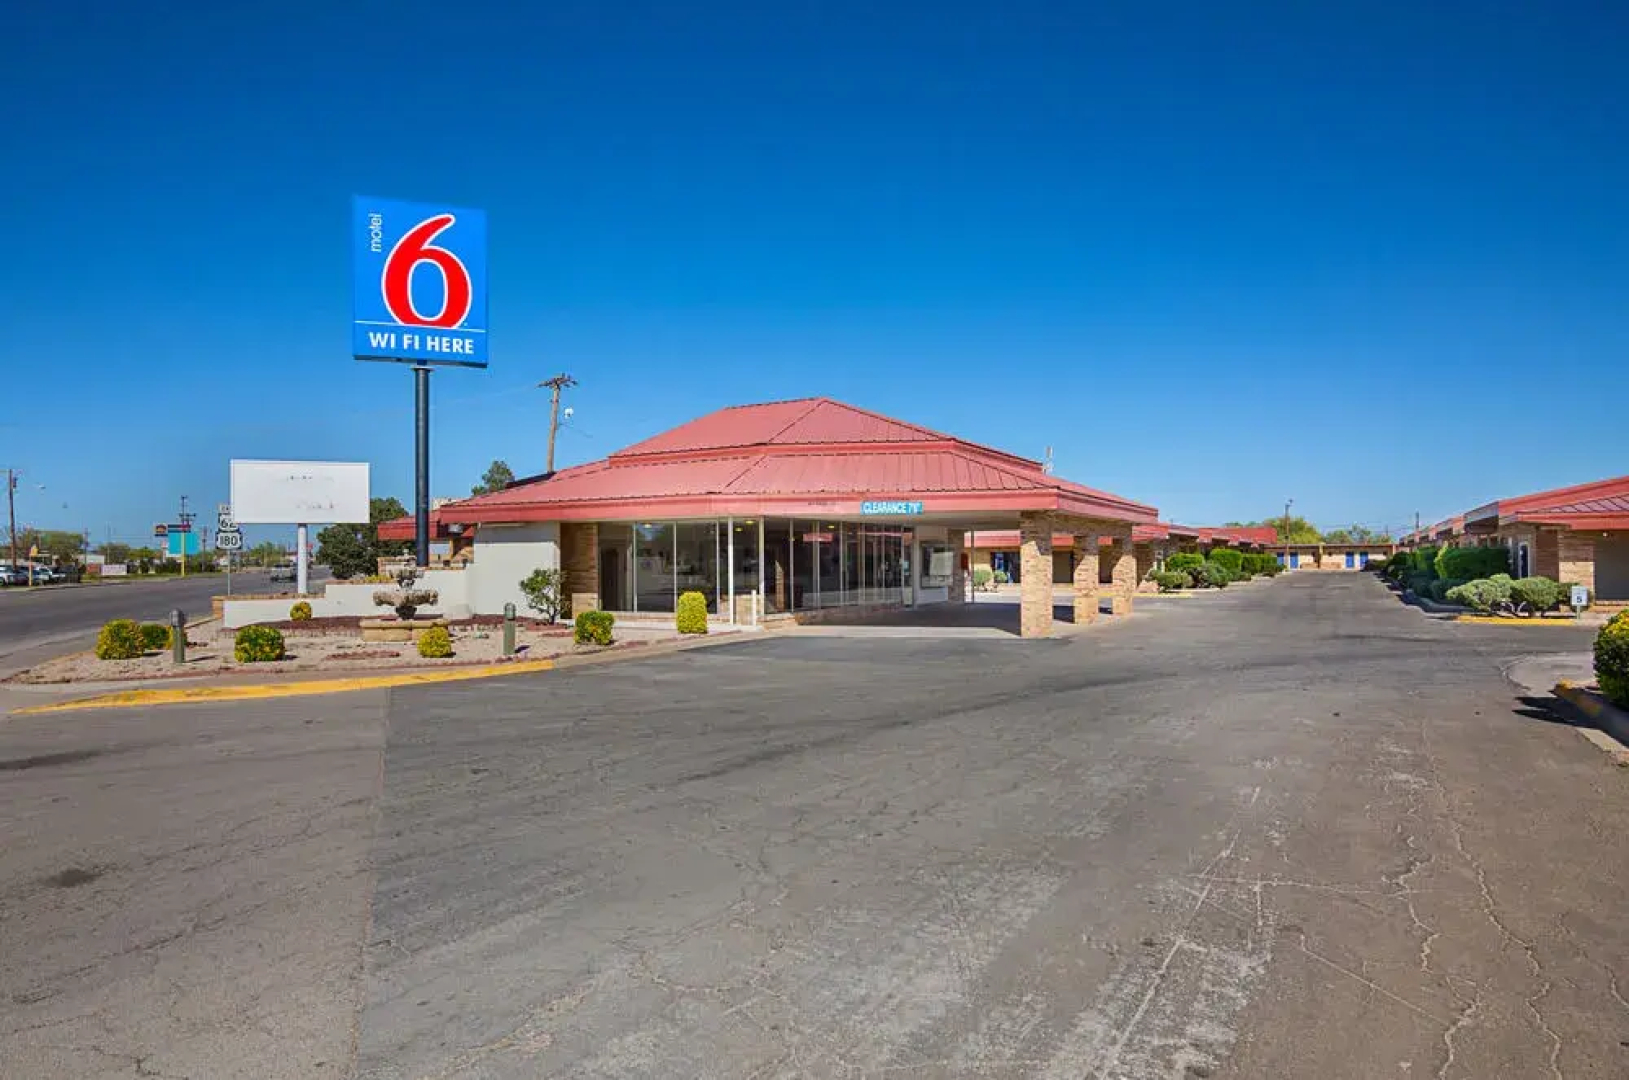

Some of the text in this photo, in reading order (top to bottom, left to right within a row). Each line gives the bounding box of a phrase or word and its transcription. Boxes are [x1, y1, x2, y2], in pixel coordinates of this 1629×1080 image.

[368, 212, 382, 252] motel
[381, 214, 472, 329] 6
[369, 332, 474, 354] WI FI HERE
[864, 501, 906, 514] CLEARANCE
[220, 535, 239, 546] 180
[1576, 595, 1583, 604] 5
